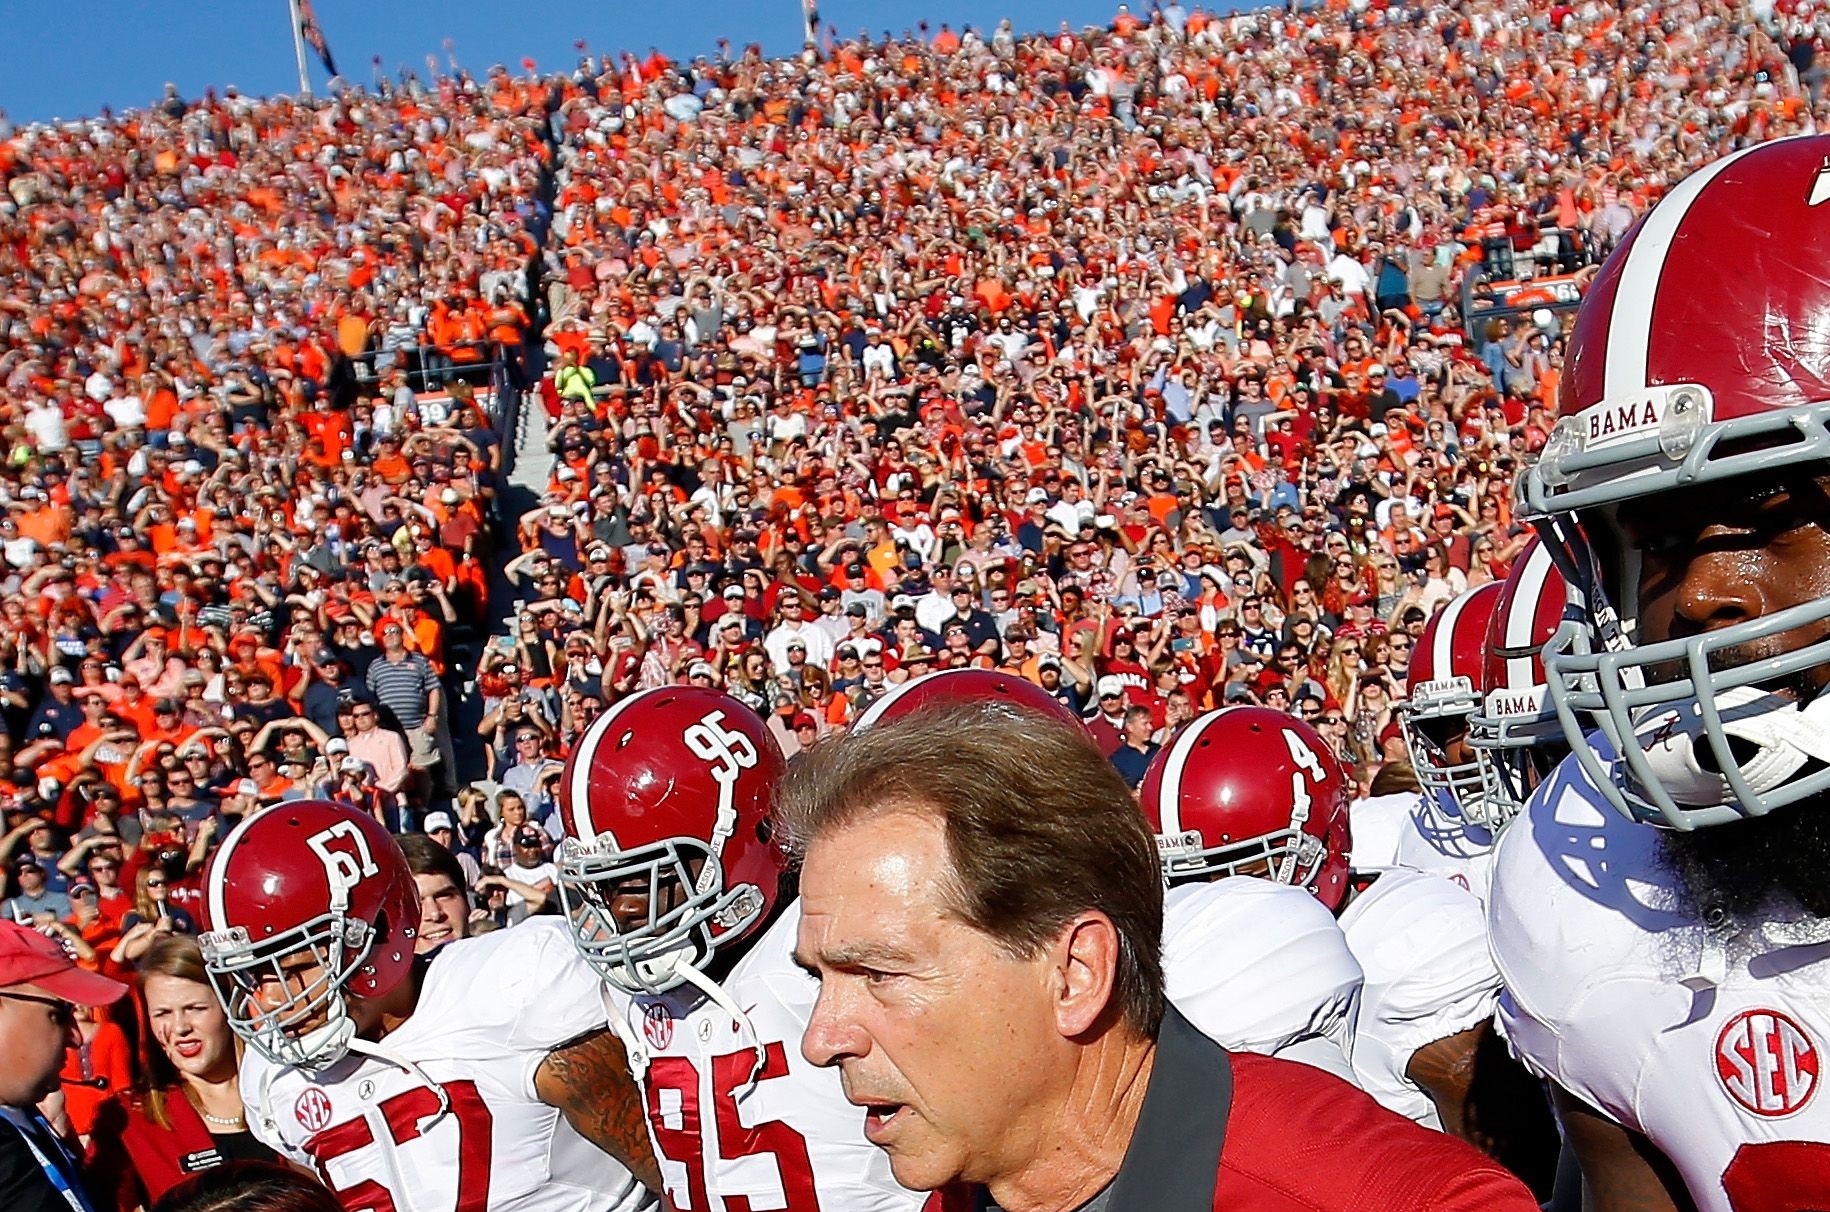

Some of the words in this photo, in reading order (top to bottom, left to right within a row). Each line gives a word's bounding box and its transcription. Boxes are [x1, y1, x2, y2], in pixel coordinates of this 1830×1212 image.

[1589, 400, 1659, 439] BAMA
[1428, 680, 1456, 692] BAMA
[1495, 695, 1538, 716] BAMA
[684, 710, 758, 783] 95
[1281, 728, 1327, 783] 4
[1717, 1010, 1821, 1113] SEC
[297, 1089, 331, 1130] SEC
